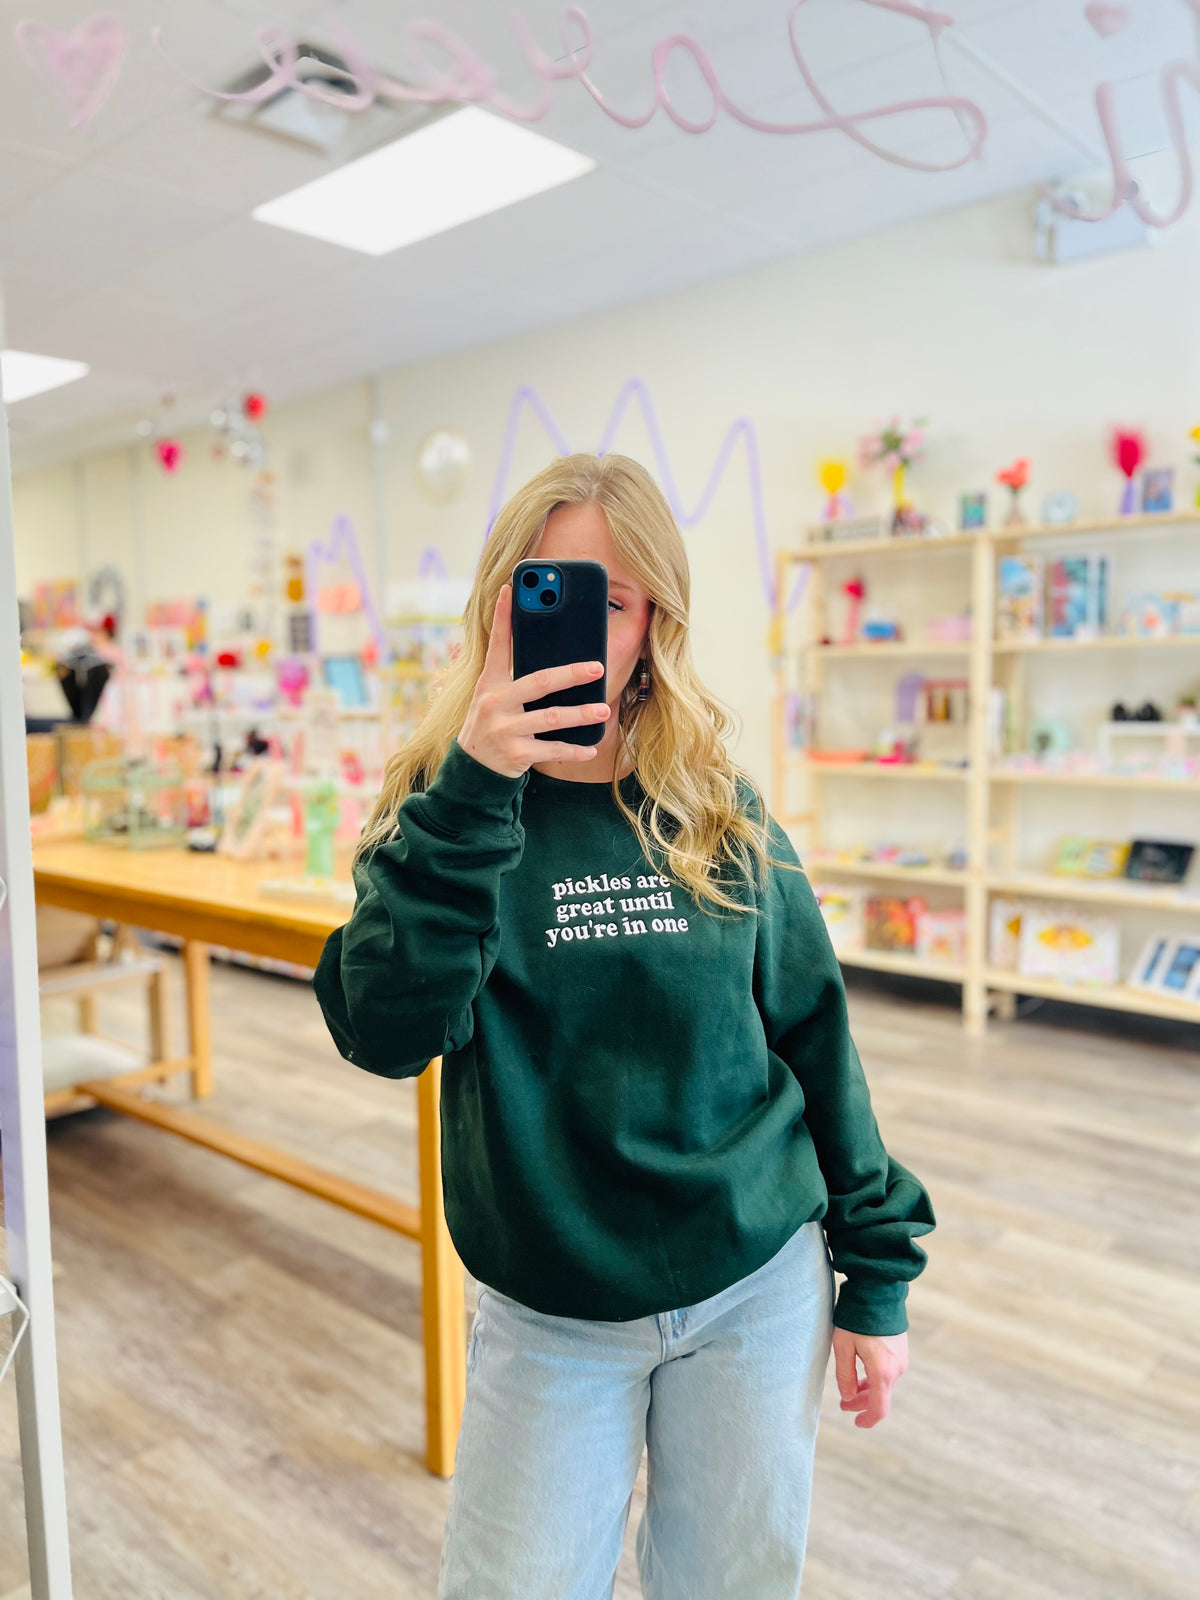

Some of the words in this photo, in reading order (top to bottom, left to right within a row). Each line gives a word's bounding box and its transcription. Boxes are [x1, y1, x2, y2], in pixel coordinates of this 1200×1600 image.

[552, 873, 632, 900] pickles
[636, 874, 671, 889] are
[556, 897, 616, 923] great
[619, 891, 675, 913] until
[545, 919, 619, 948] you're
[621, 916, 648, 936] in
[651, 917, 689, 933] one
